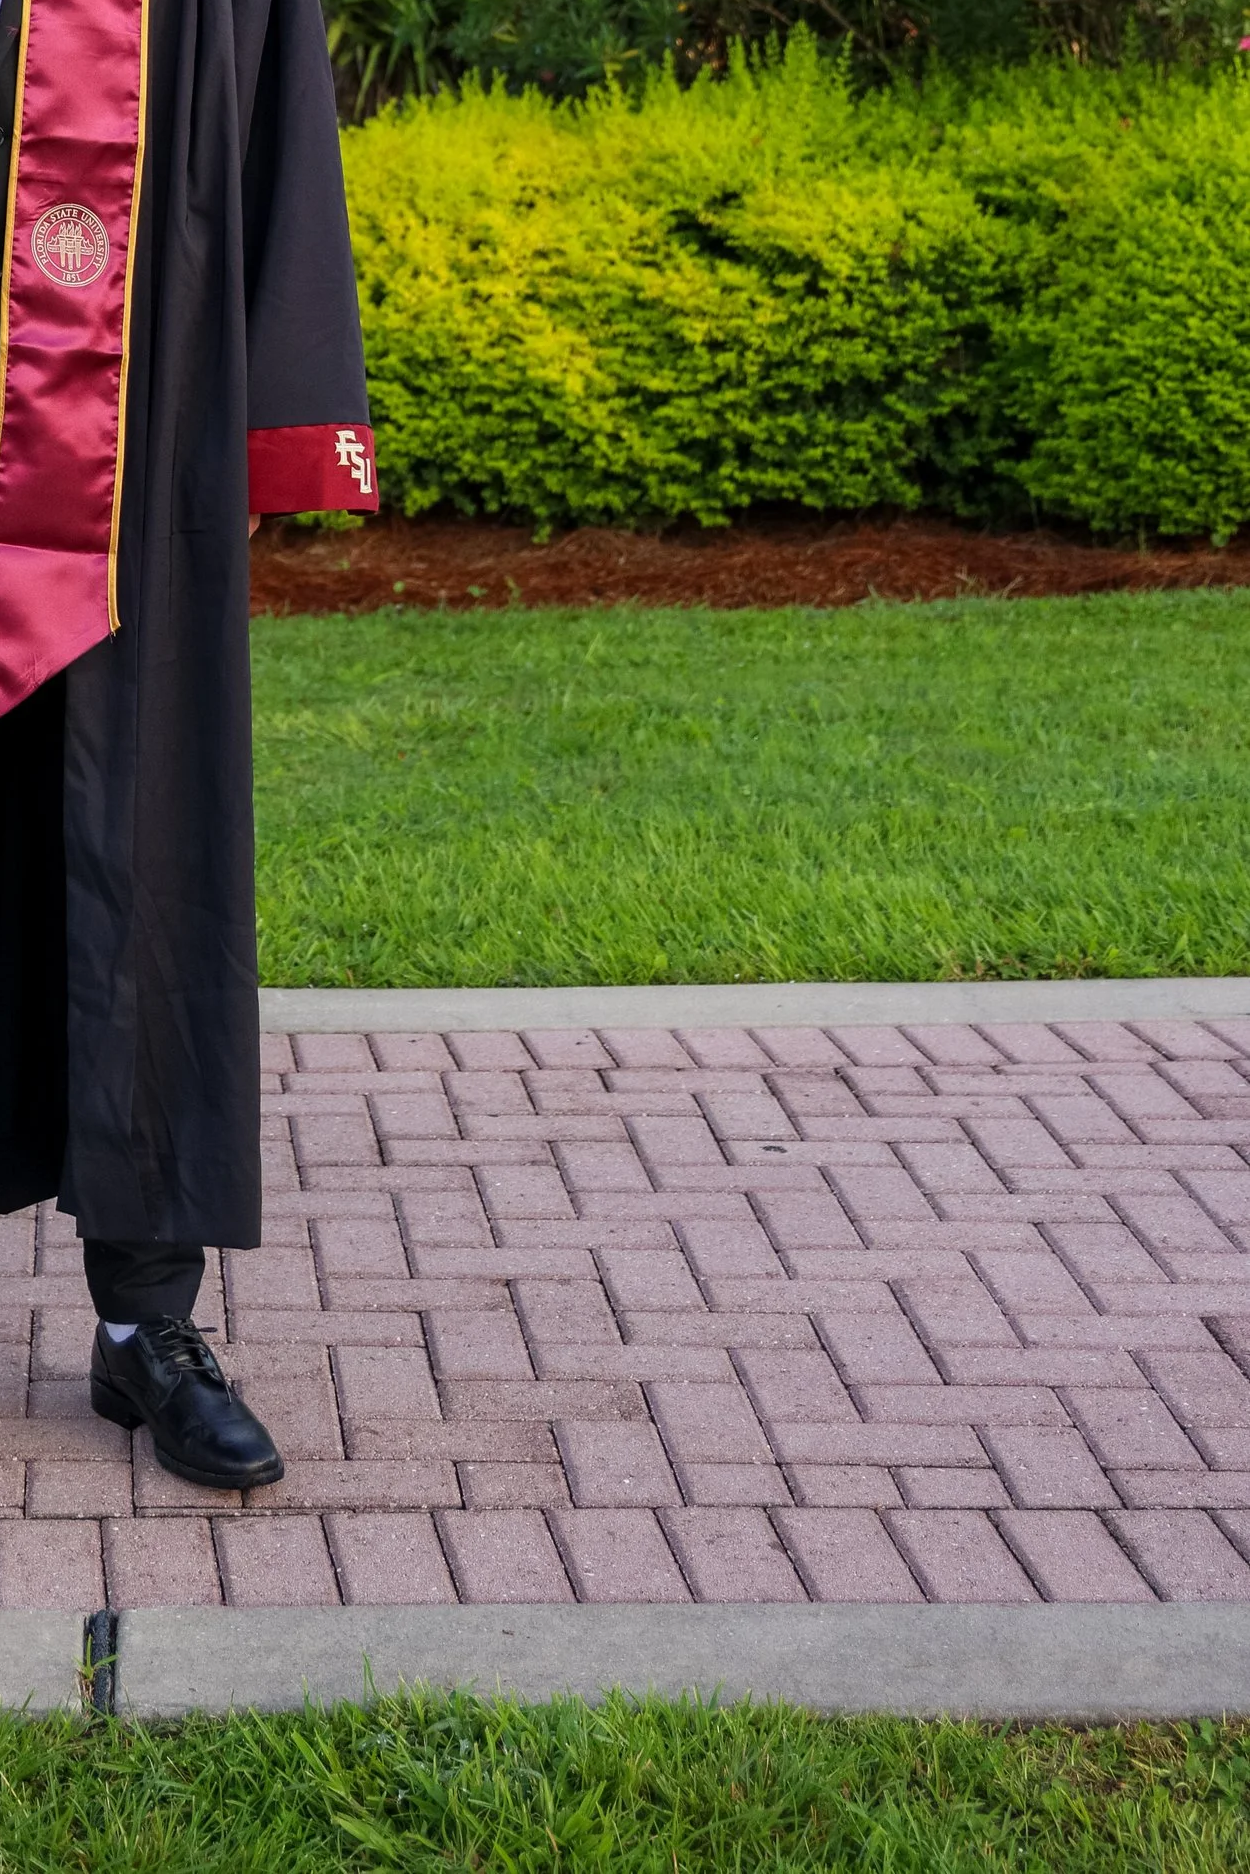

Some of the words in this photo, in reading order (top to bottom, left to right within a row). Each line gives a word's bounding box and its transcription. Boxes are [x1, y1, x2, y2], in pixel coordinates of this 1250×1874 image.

[37, 221, 50, 264] FLORIDA
[50, 209, 78, 223] STATE
[81, 212, 105, 269] UNIVERSITY
[61, 272, 81, 282] 1851
[334, 429, 373, 494] FSU
